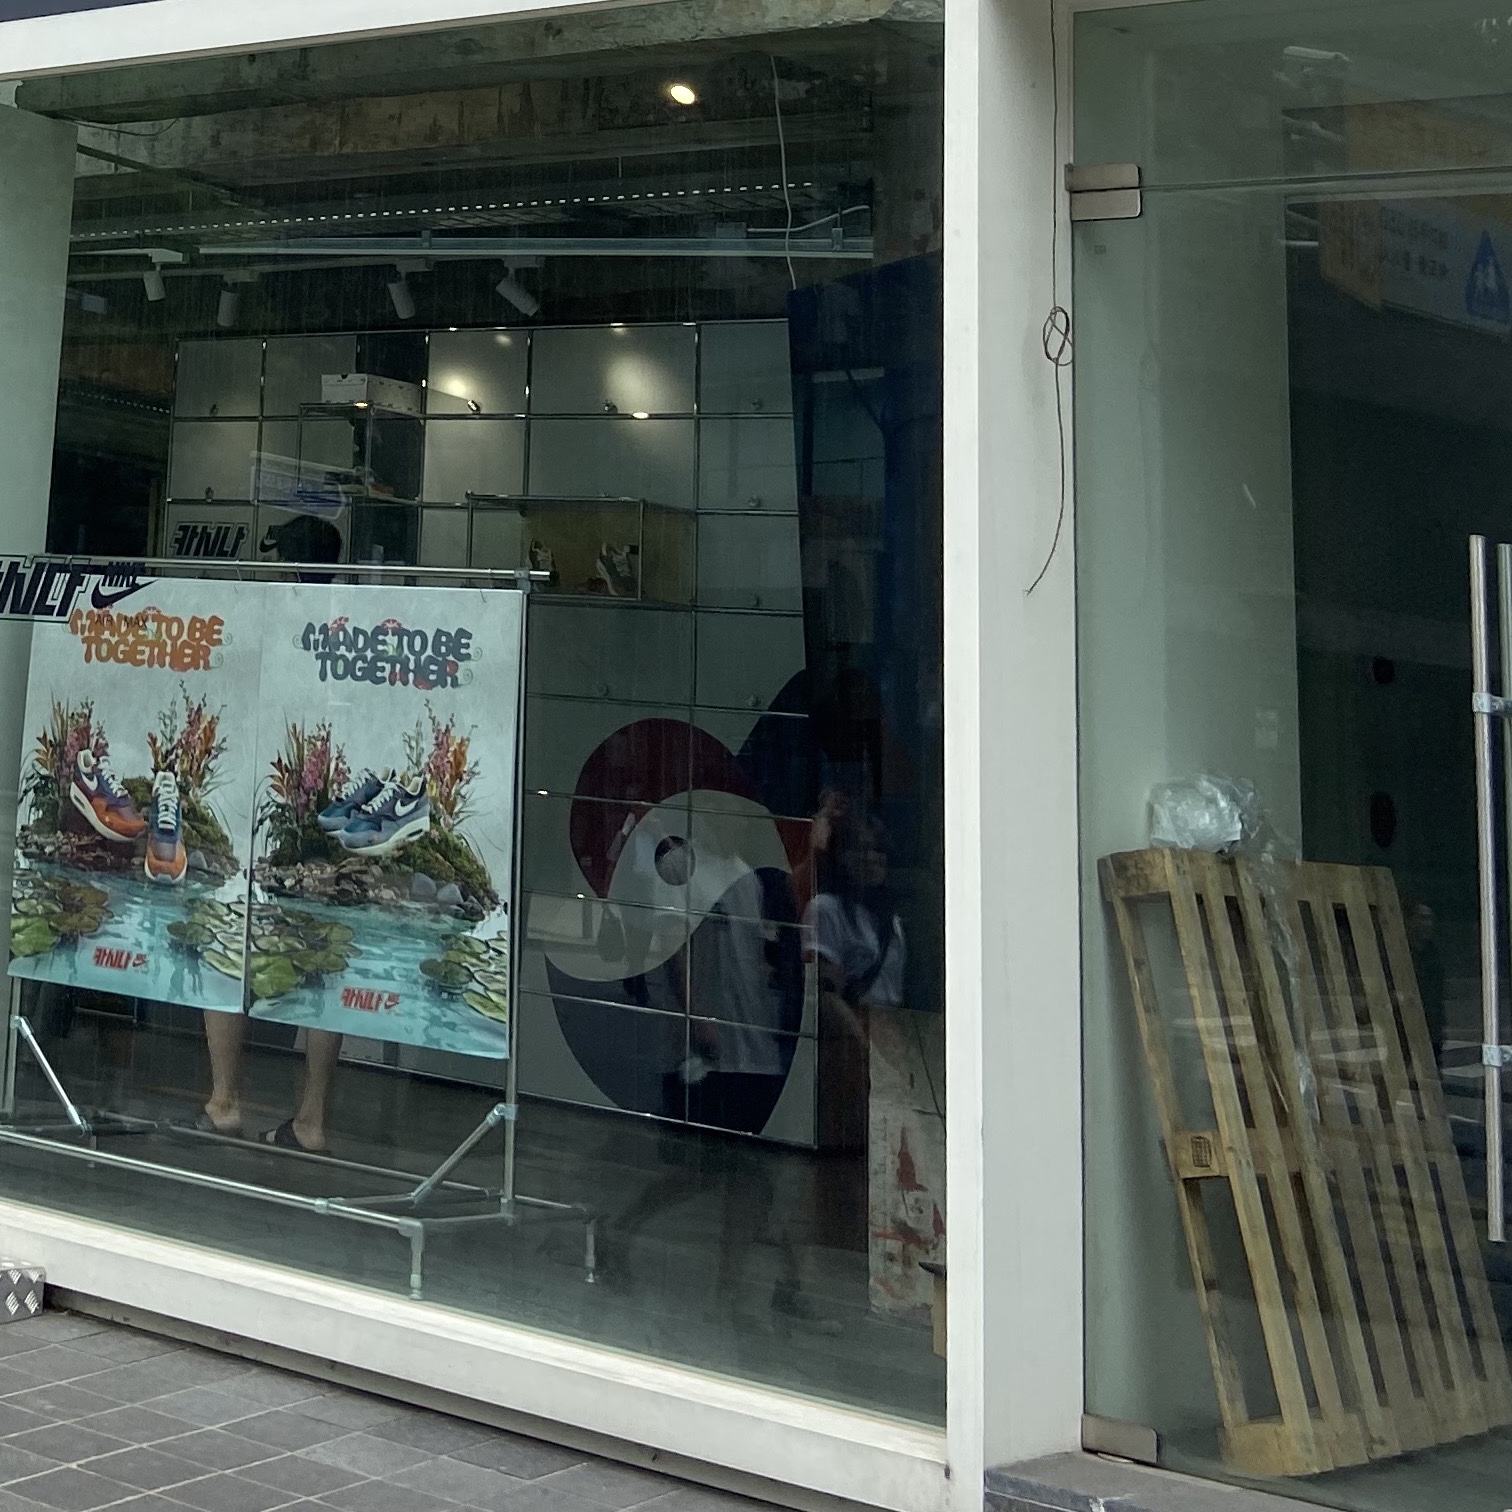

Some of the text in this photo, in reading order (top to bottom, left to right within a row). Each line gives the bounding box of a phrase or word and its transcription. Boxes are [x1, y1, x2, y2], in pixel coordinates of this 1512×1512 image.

[101, 561, 146, 588] NIKE
[69, 608, 226, 646] MADE TO BE
[302, 620, 473, 661] MADE TO BE
[82, 635, 211, 672] TOGETHER
[315, 651, 459, 690] TOGETHER
